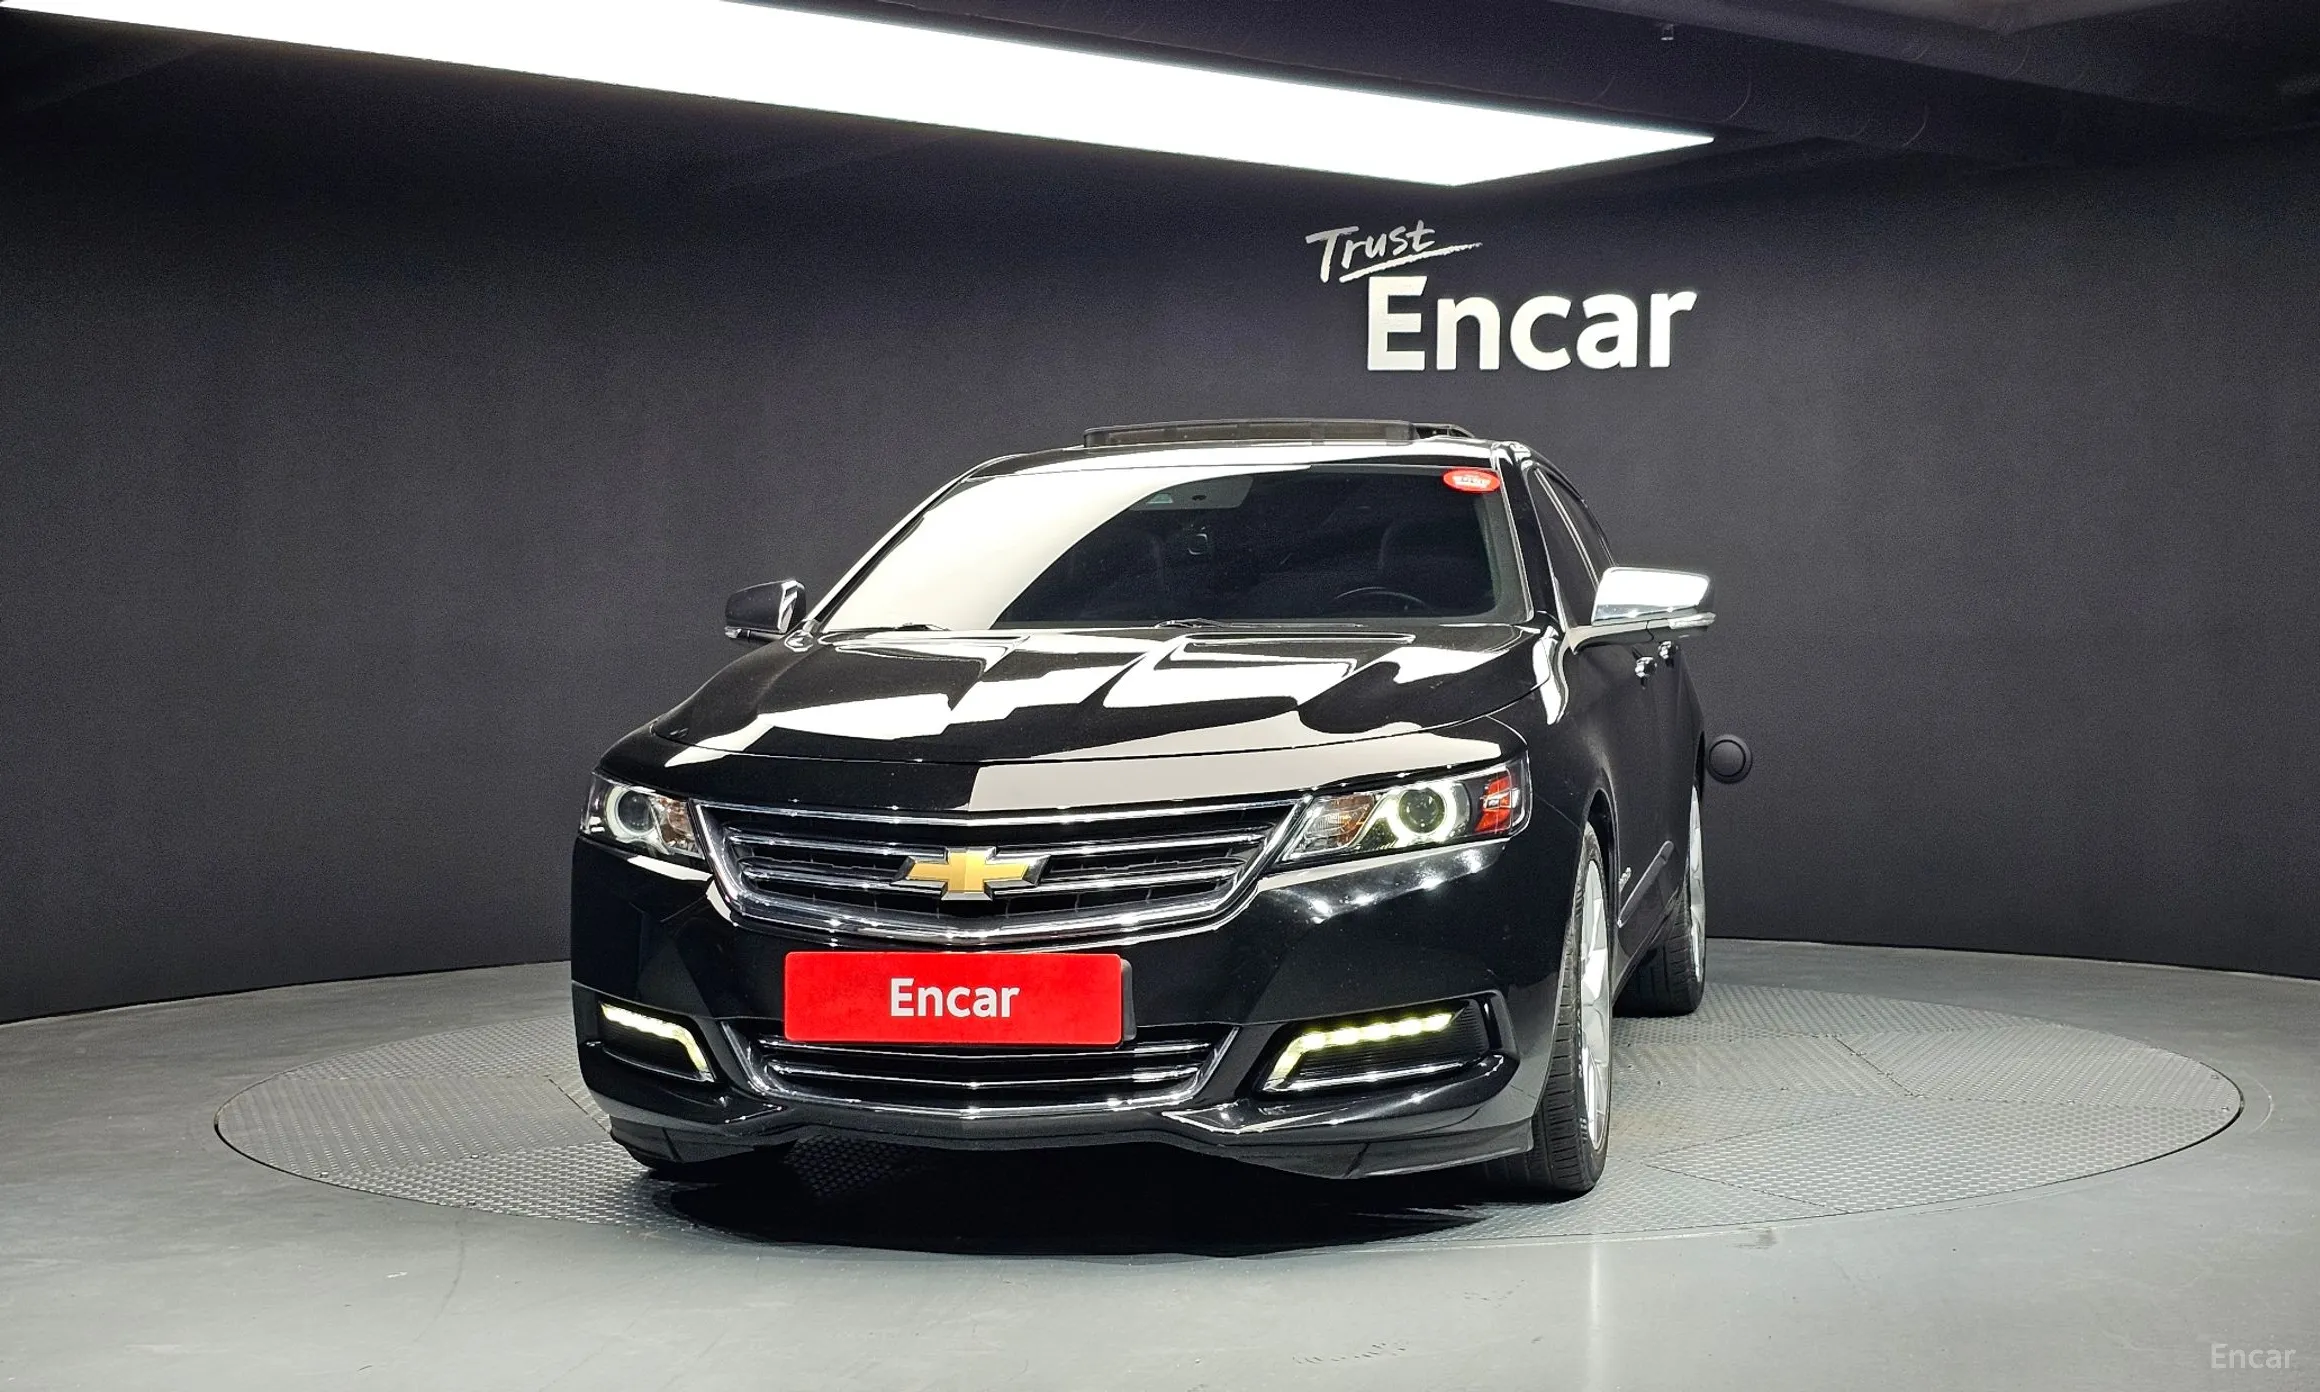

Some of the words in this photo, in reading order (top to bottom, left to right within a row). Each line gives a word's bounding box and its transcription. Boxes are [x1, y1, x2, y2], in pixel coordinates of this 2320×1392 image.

[1305, 219, 1437, 284] Trust
[1367, 275, 1699, 371] Encar
[890, 977, 1020, 1018] Encar
